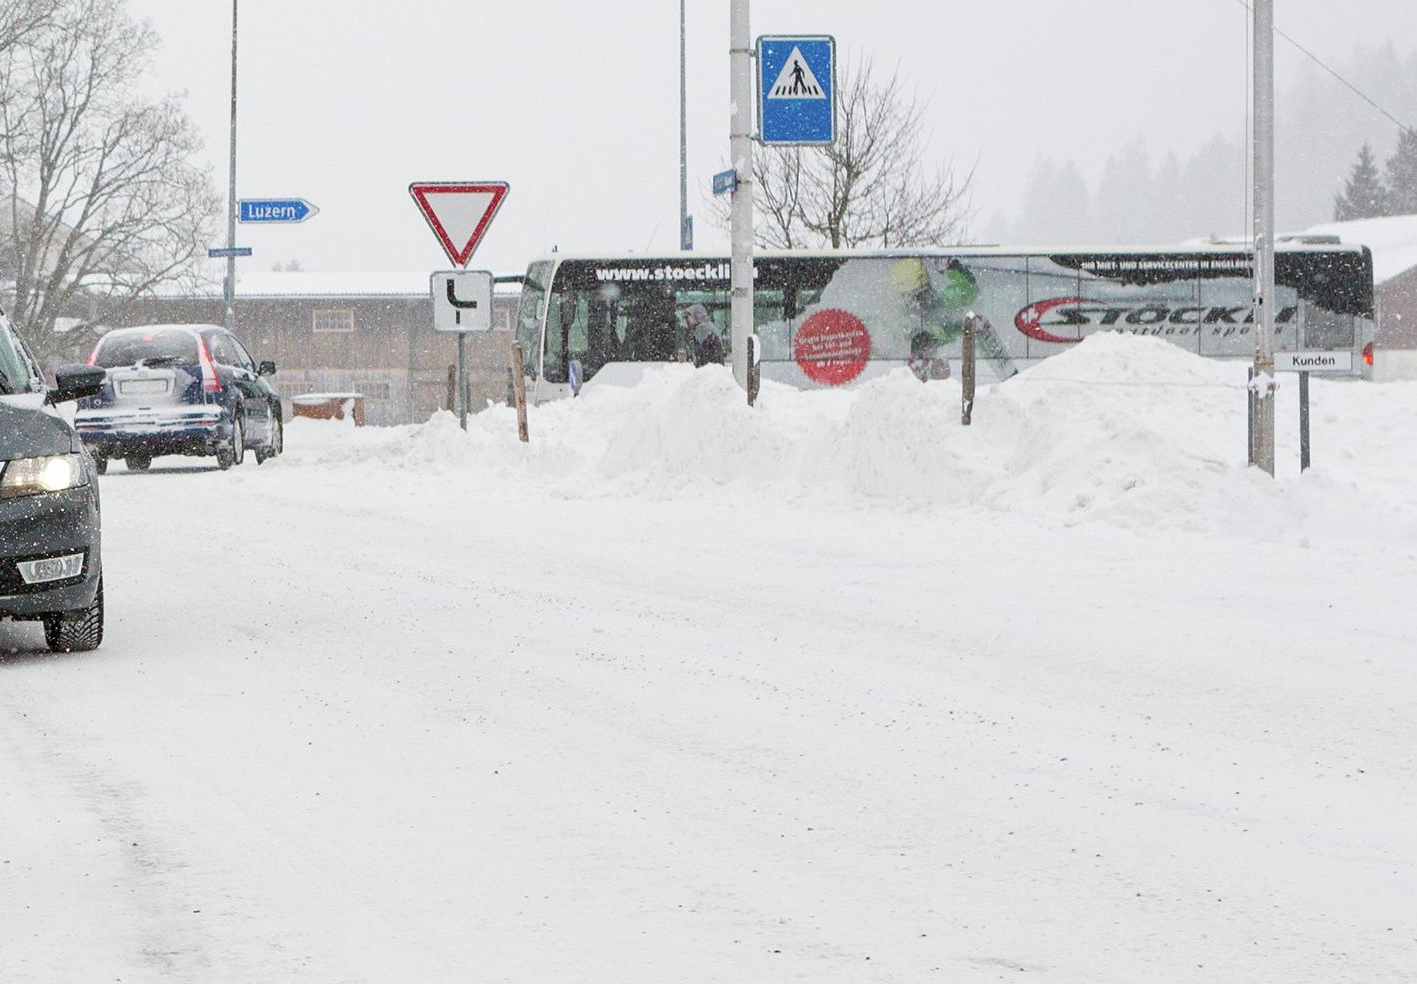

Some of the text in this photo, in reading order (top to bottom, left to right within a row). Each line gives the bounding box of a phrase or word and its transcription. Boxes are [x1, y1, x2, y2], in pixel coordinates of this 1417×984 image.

[248, 203, 295, 218] Luzern
[1201, 260, 1209, 269] IN
[1212, 326, 1283, 338] spos
[1292, 355, 1335, 366] Kunden
